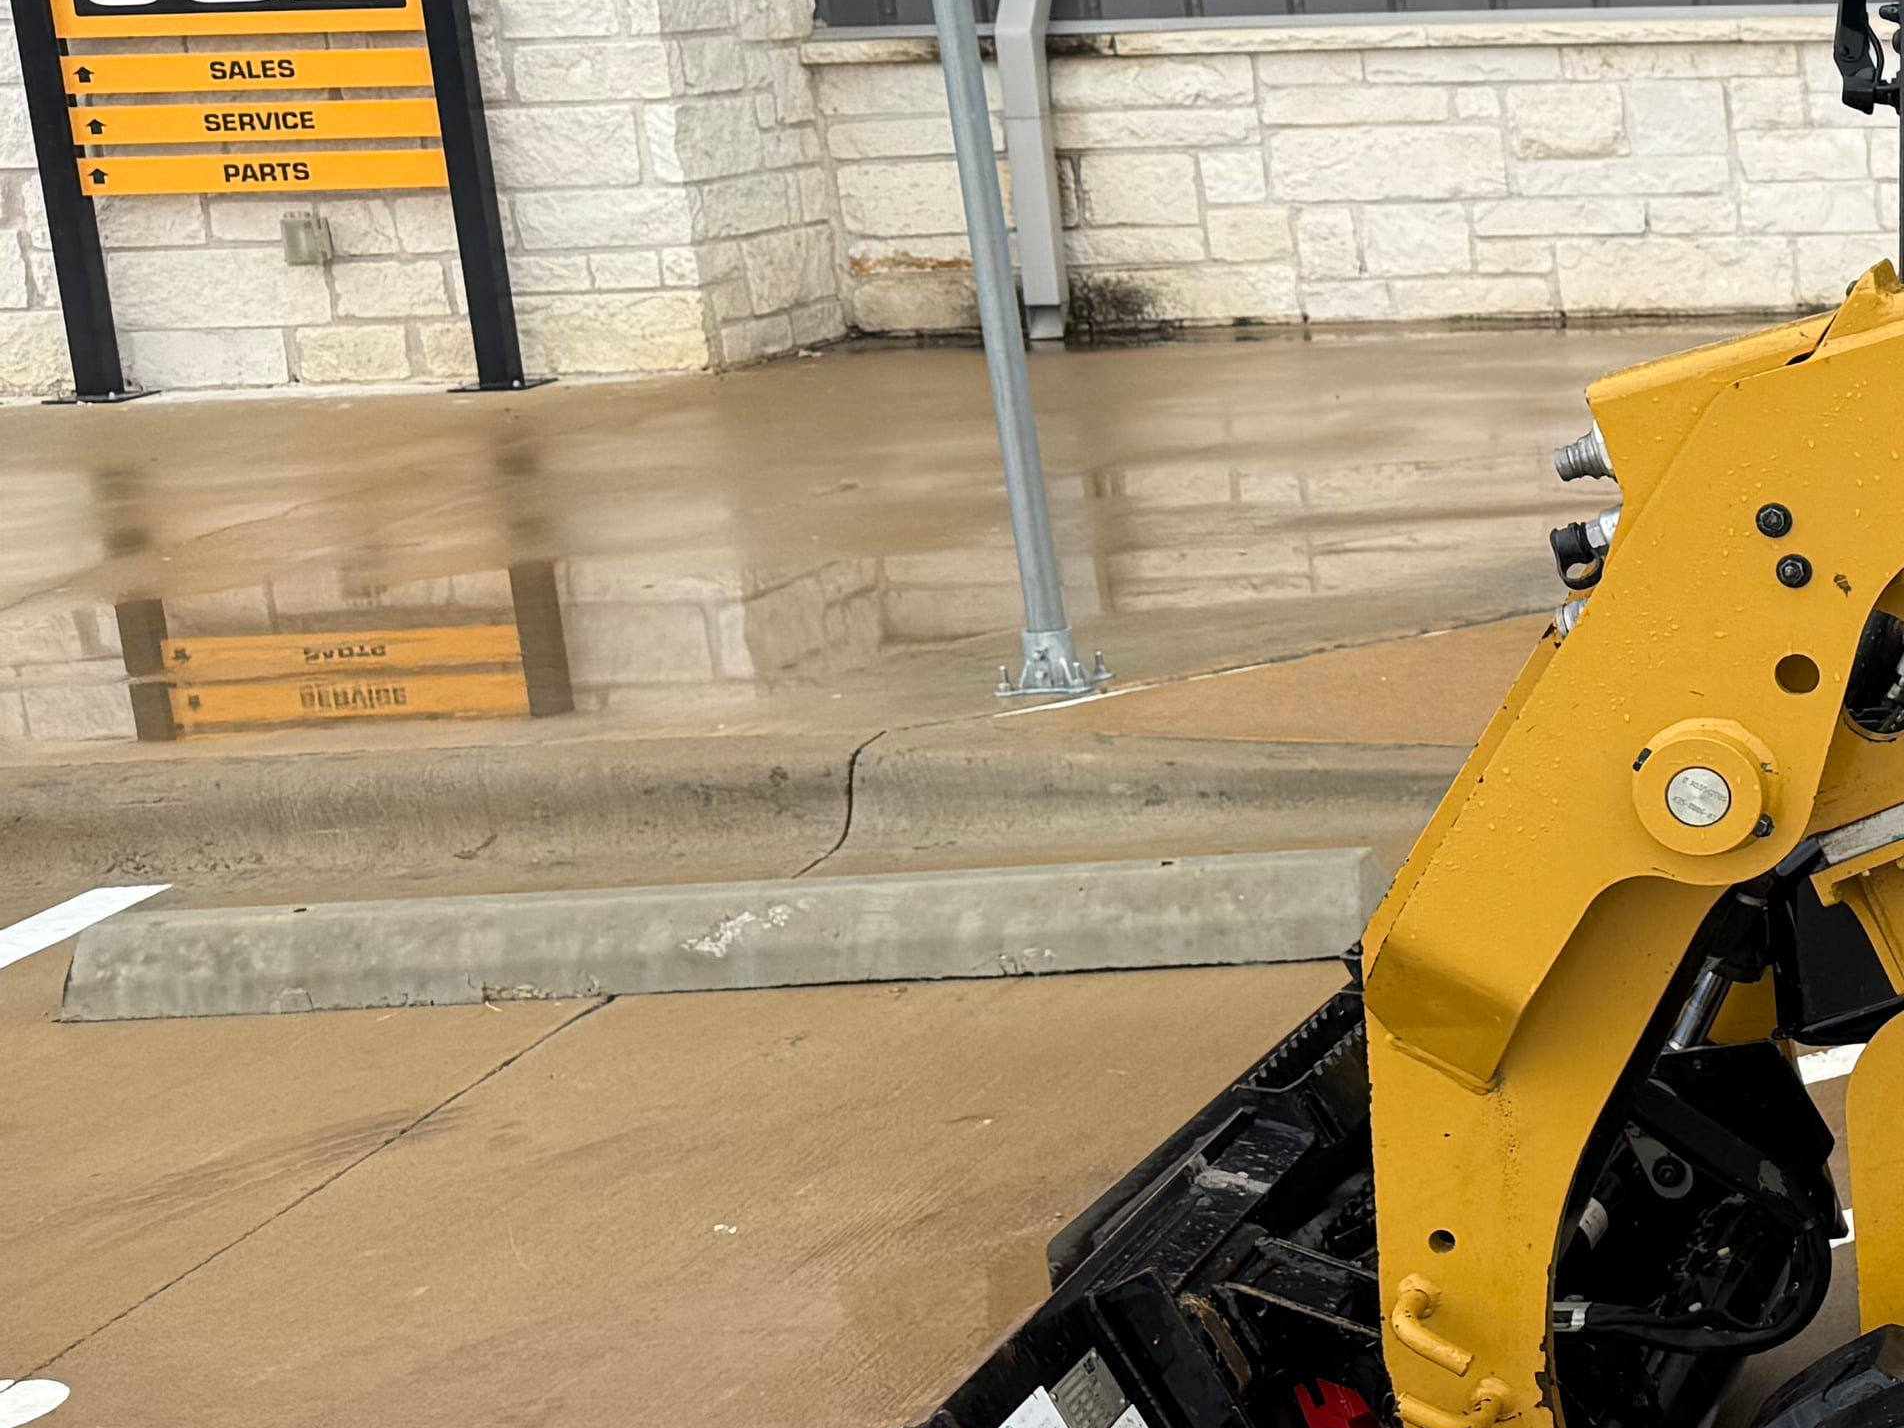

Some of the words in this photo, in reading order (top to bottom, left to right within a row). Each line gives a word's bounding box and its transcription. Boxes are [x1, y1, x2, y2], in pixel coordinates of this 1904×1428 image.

[209, 59, 295, 80] SALES
[204, 110, 315, 133] SERVICE
[223, 162, 310, 183] PARTS
